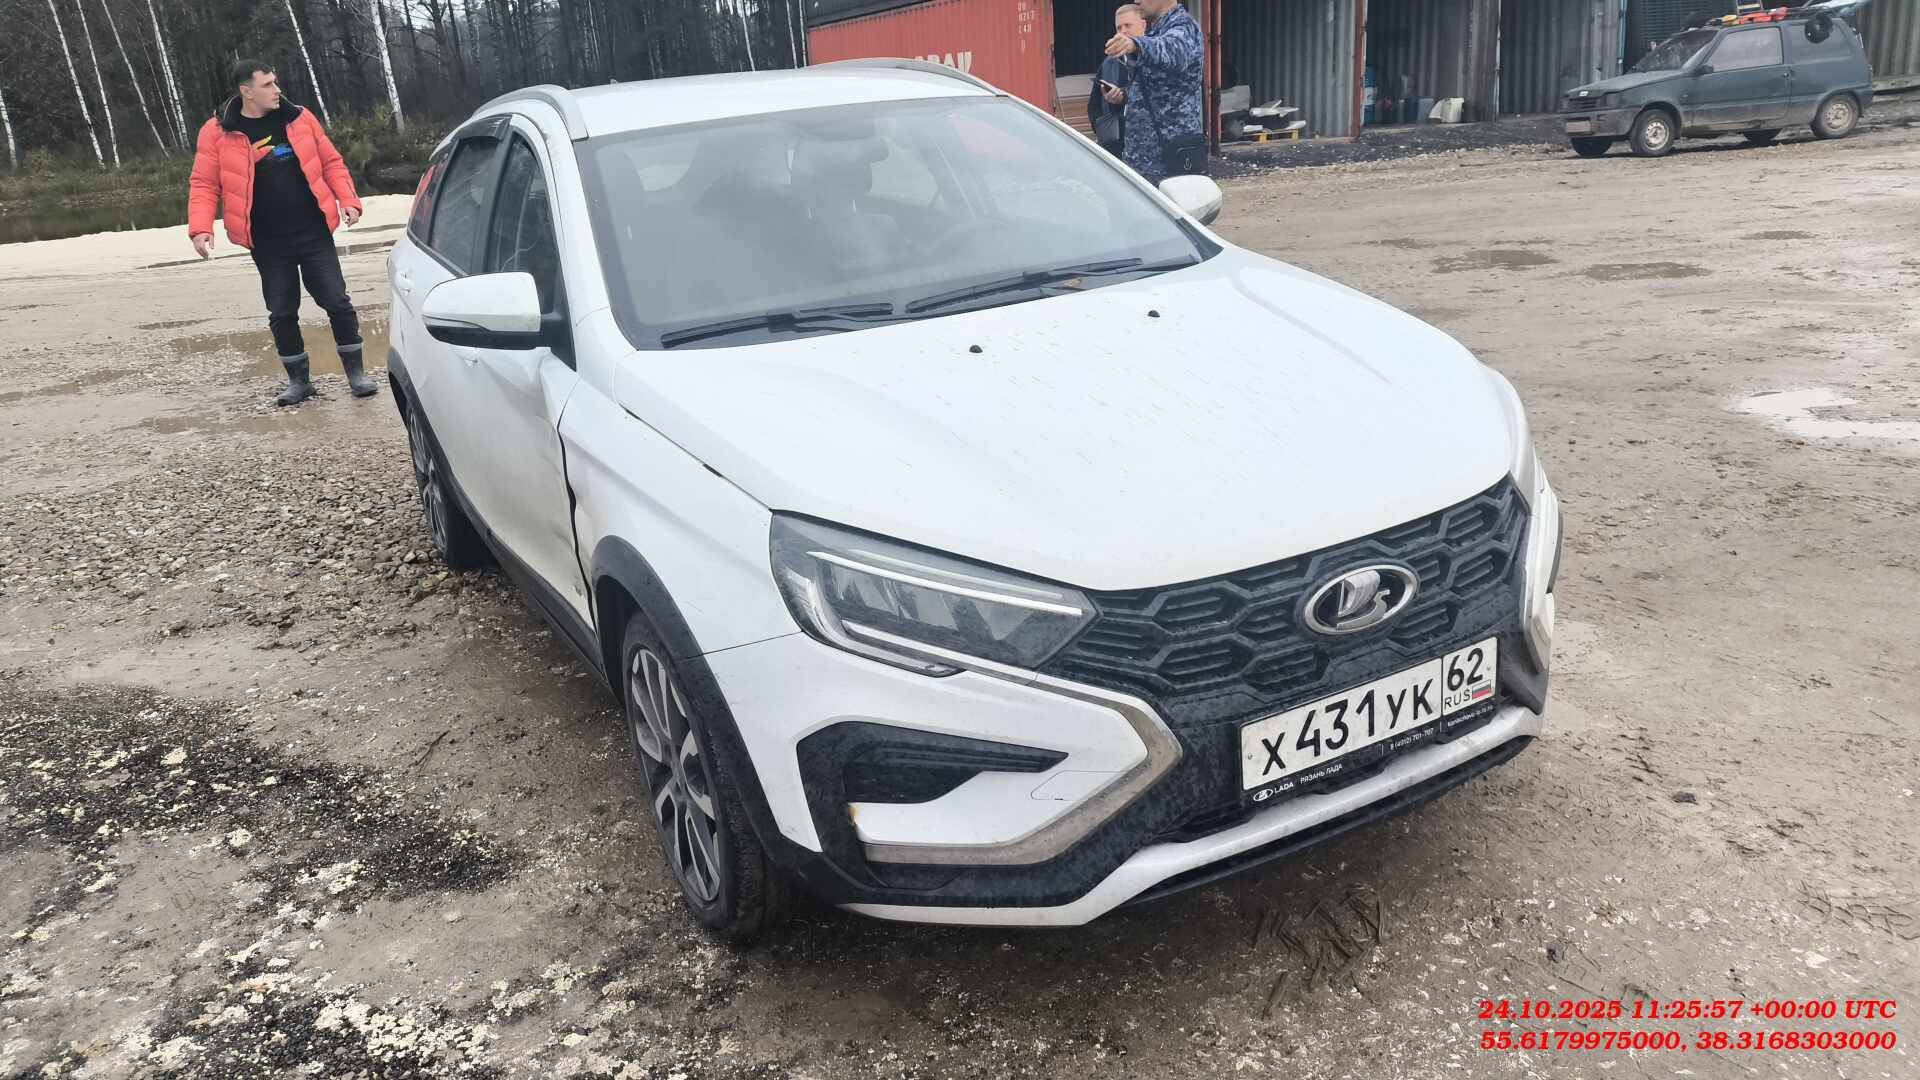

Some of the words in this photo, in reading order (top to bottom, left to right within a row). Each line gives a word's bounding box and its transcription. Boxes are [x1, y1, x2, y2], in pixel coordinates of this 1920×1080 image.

[1447, 647, 1484, 691] 62
[1443, 690, 1471, 710] RUS
[1300, 770, 1325, 784] РЯЗАНЬ
[1326, 763, 1343, 775] ЛАДА
[1274, 781, 1294, 794] LADA
